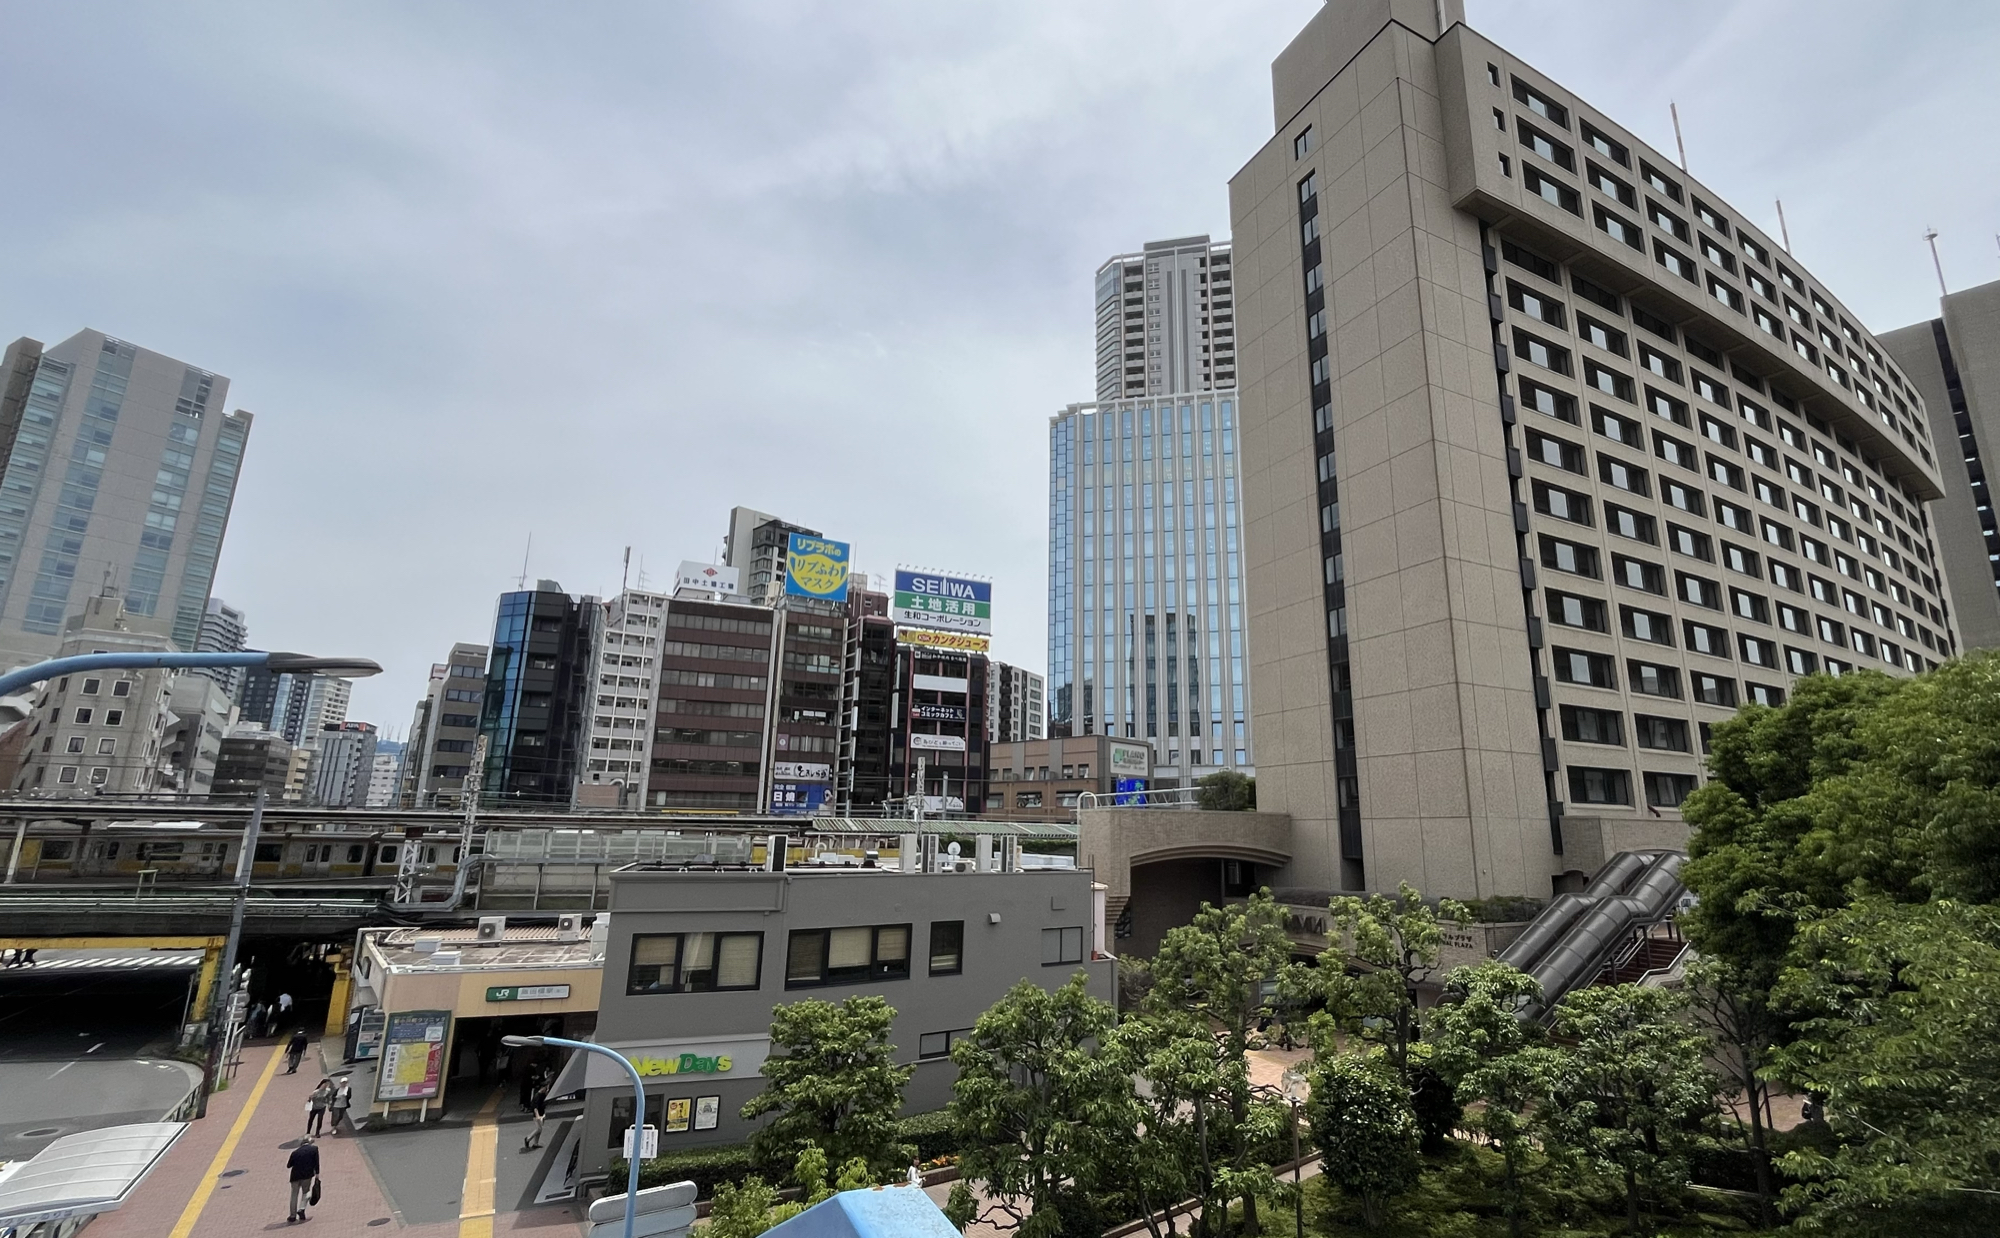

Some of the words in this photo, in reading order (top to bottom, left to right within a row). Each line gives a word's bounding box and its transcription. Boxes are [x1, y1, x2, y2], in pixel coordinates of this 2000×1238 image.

[800, 576, 834, 590] マスク
[910, 595, 976, 616] 土地活用
[904, 610, 981, 628] 生和コーポレーション
[496, 988, 510, 997] JR
[626, 1053, 733, 1077] NewDays
